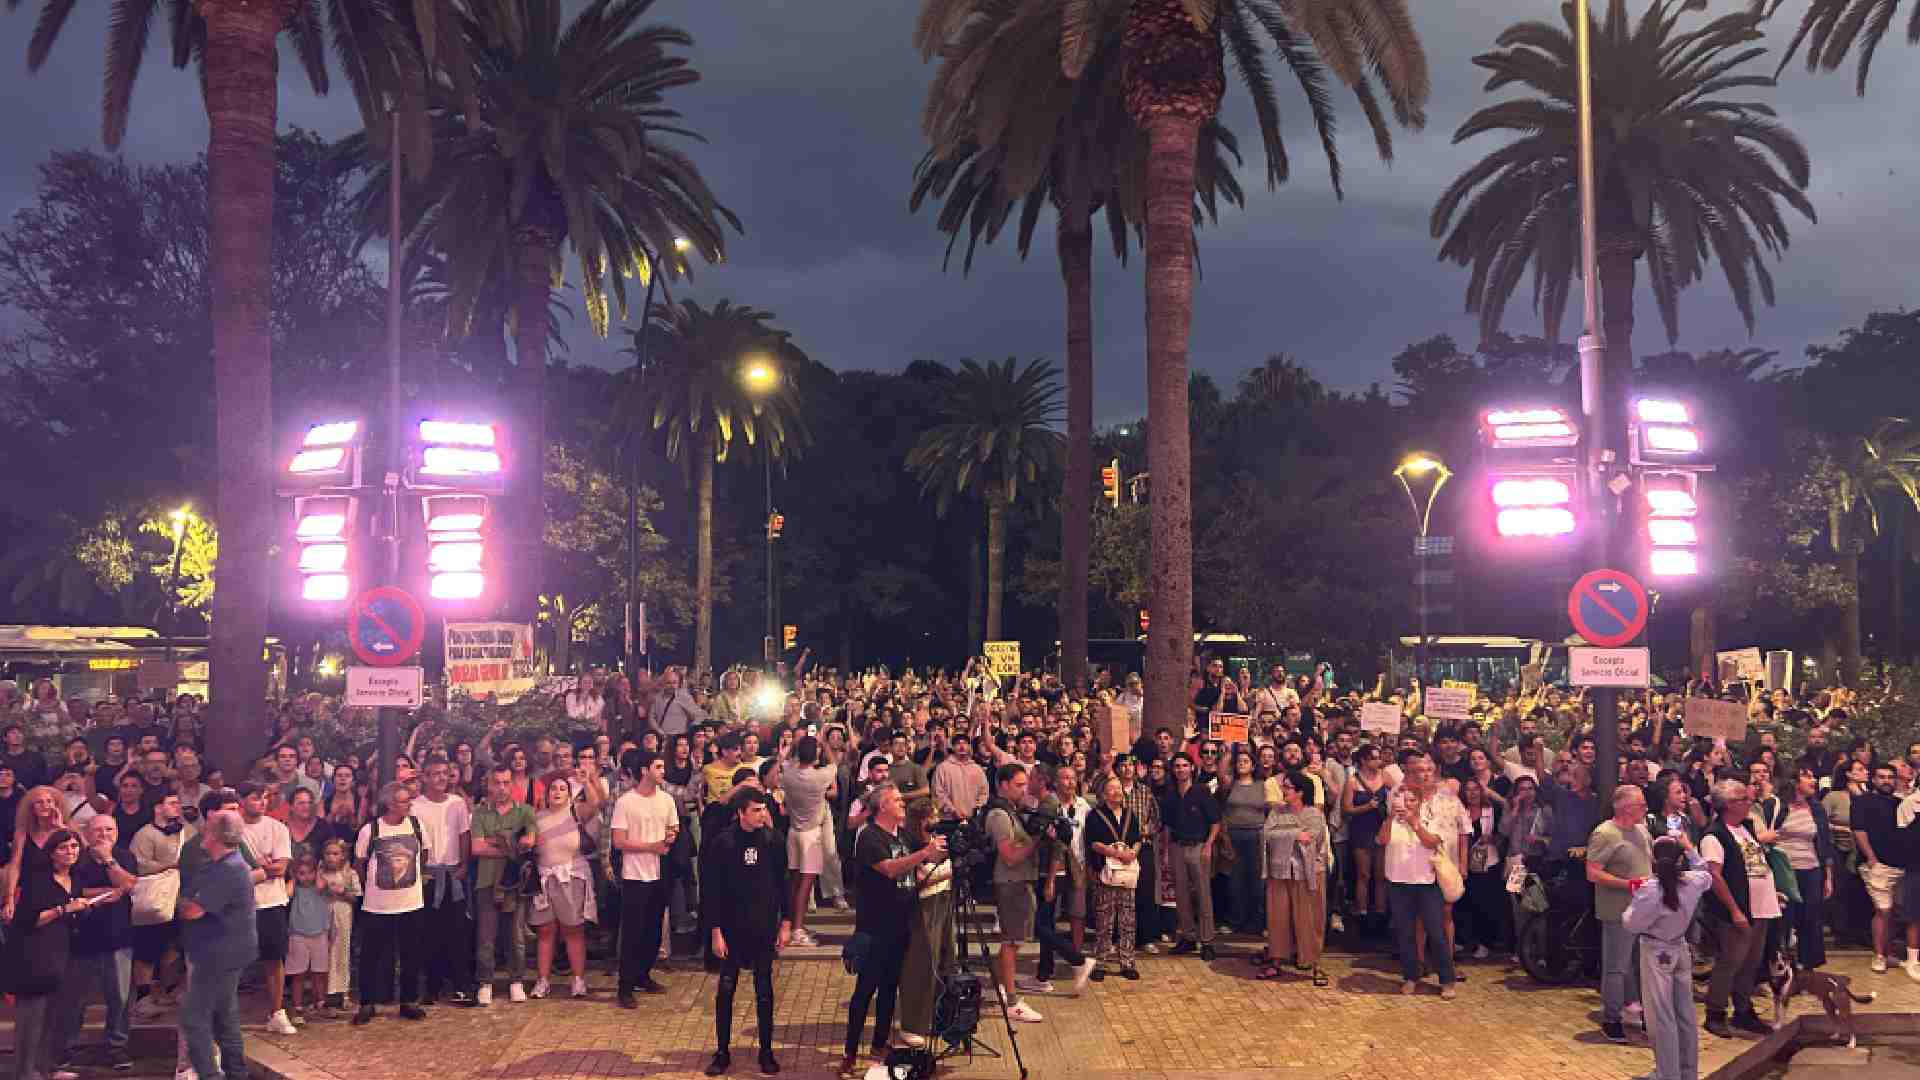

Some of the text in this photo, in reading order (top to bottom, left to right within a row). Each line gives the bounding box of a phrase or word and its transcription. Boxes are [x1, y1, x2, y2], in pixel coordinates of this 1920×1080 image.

[1593, 655, 1625, 666] Excepto
[1582, 667, 1640, 676] Servicio Oficial
